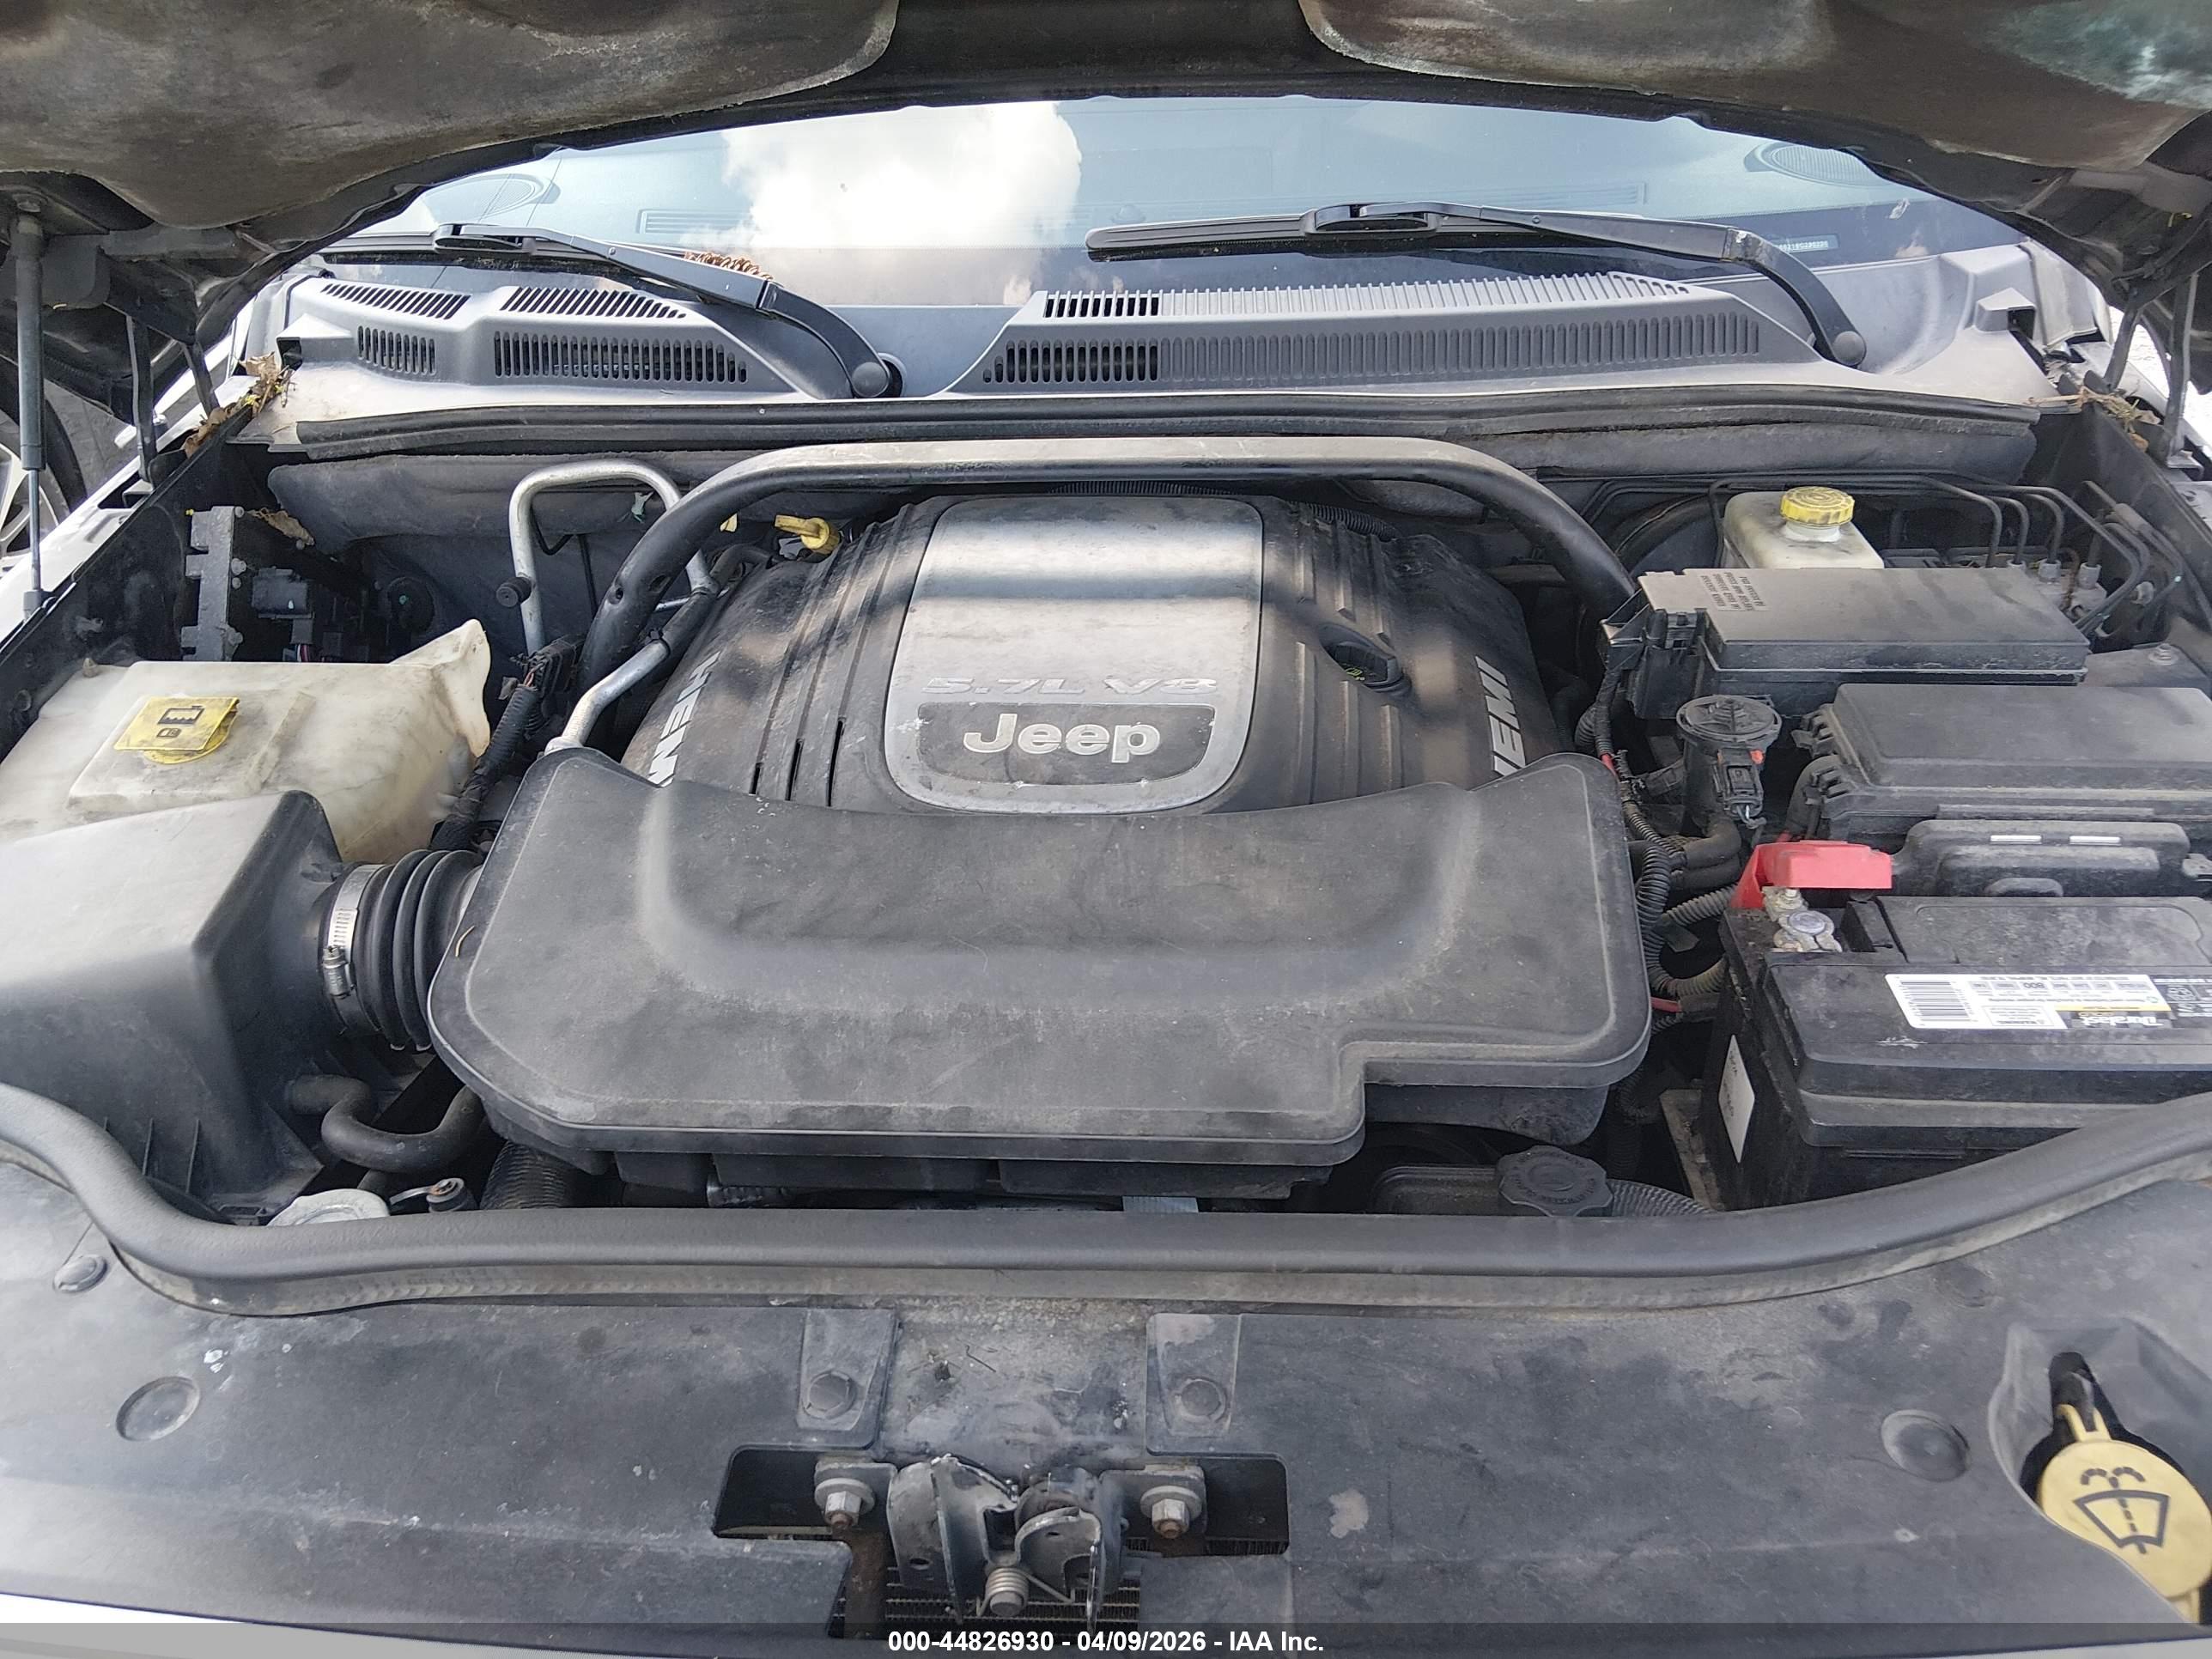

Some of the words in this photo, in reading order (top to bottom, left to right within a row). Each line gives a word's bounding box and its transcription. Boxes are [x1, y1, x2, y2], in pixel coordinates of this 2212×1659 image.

[922, 677, 1085, 695] 5.7L
[1104, 678, 1217, 695] V8
[963, 714, 1161, 763] Jeep
[2078, 1014, 2164, 1027] Duralast
